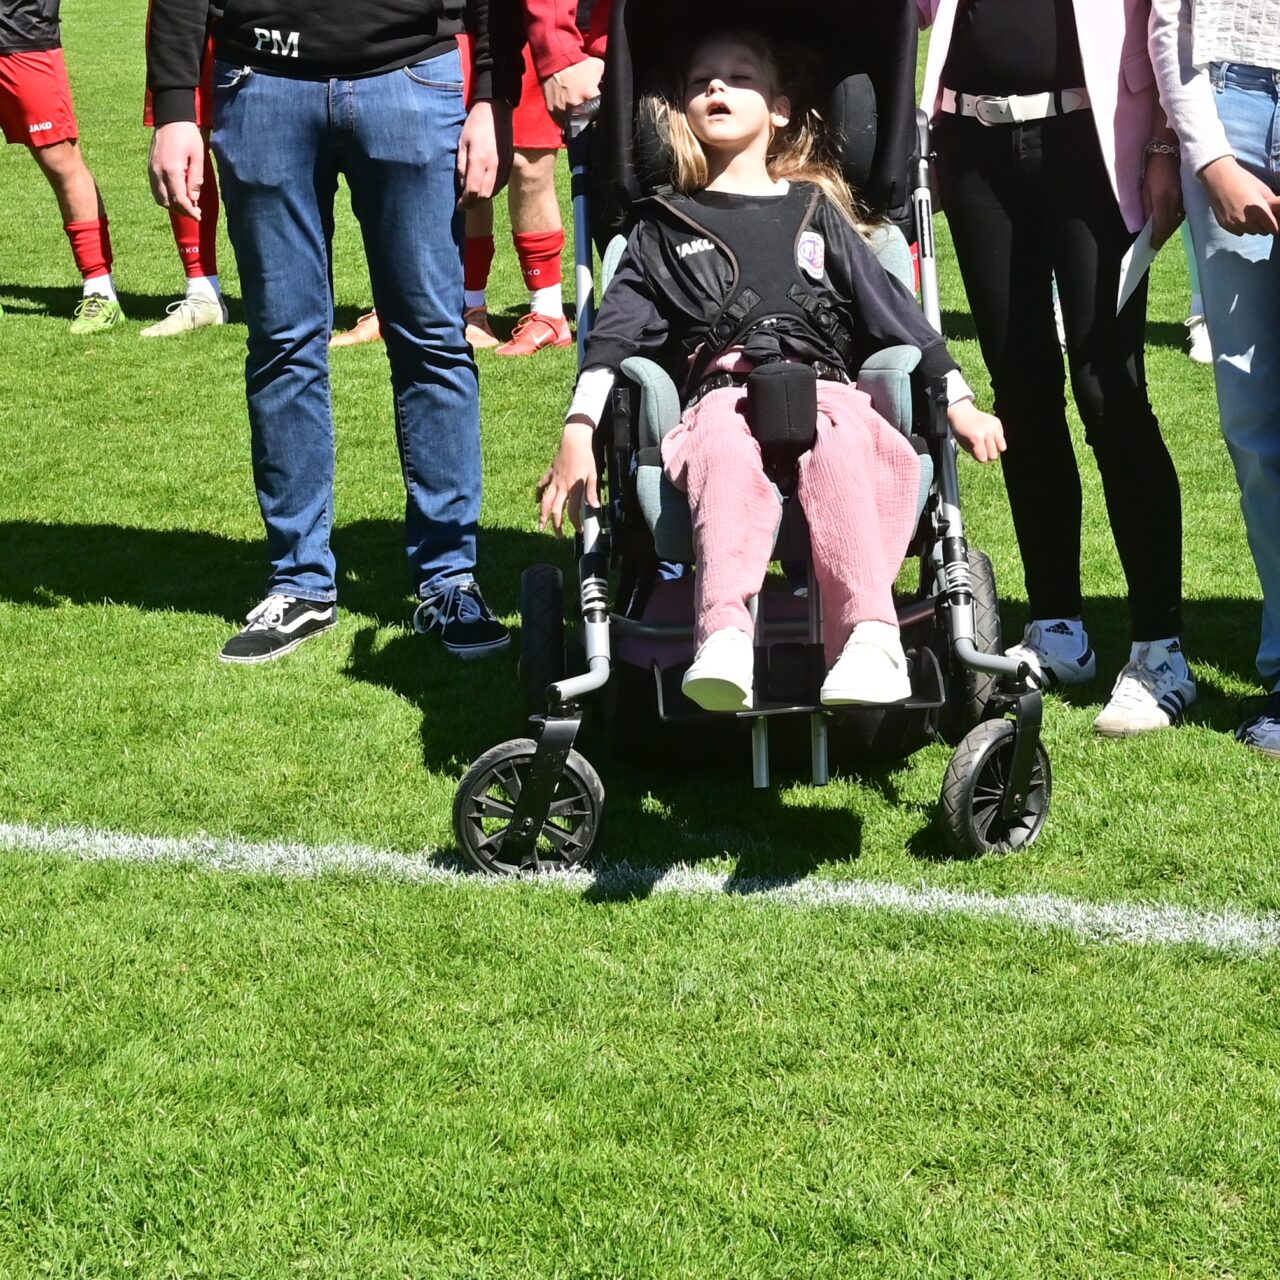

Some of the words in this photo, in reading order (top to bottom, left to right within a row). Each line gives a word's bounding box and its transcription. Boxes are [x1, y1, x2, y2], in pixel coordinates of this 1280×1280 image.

[254, 28, 300, 58] PM
[29, 121, 53, 132] JAKO
[1044, 626, 1074, 636] adidas
